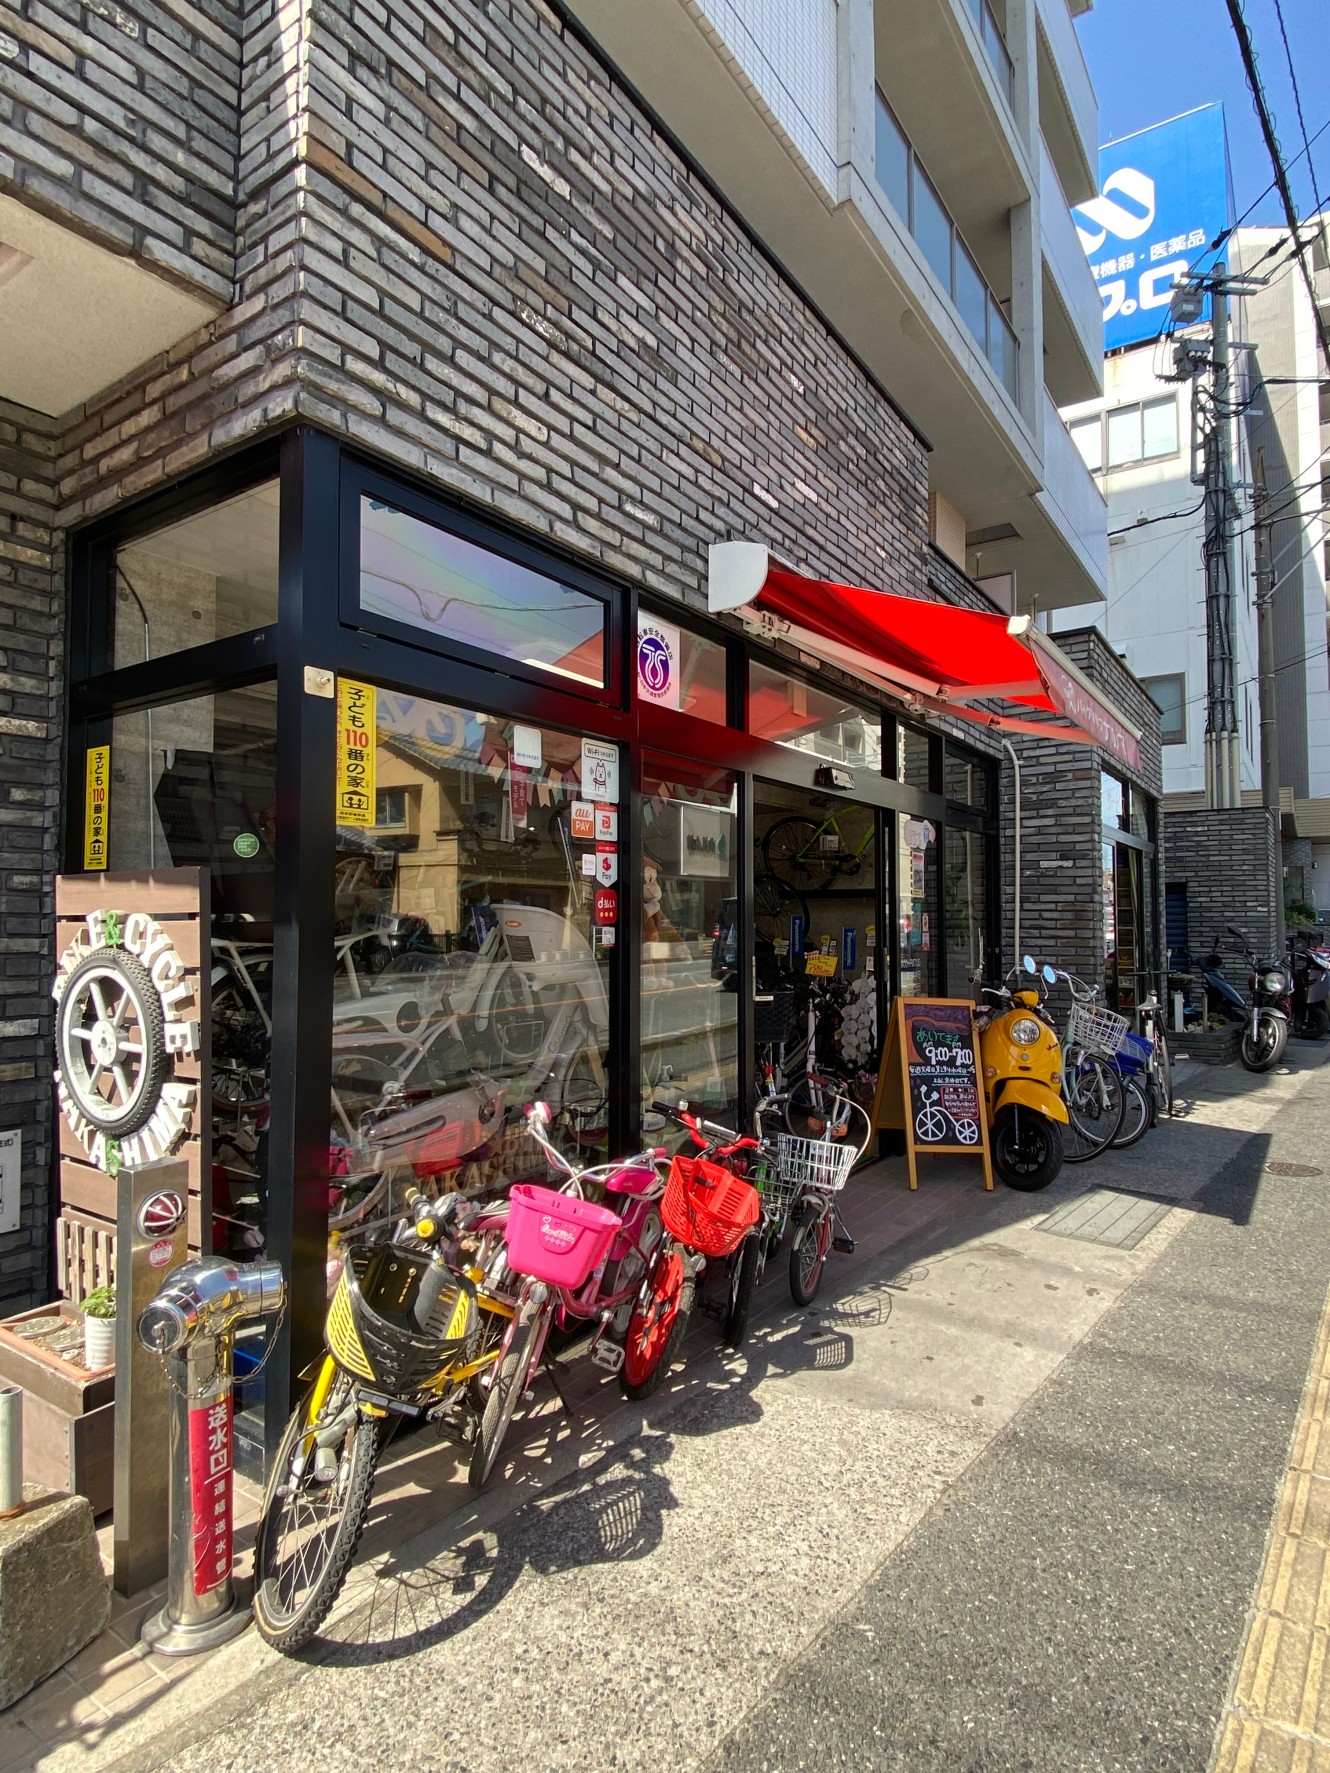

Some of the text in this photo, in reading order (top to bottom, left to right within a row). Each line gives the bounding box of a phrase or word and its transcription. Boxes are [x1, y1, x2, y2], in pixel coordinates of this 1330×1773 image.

[345, 686, 370, 789] 子ども110番の家
[92, 752, 105, 838] 子ども110番の家
[575, 808, 591, 818] au
[576, 821, 590, 832] PAY
[123, 912, 201, 1054] CYCLE
[208, 1402, 228, 1475] 送水口
[214, 1479, 226, 1575] 連結送水管
